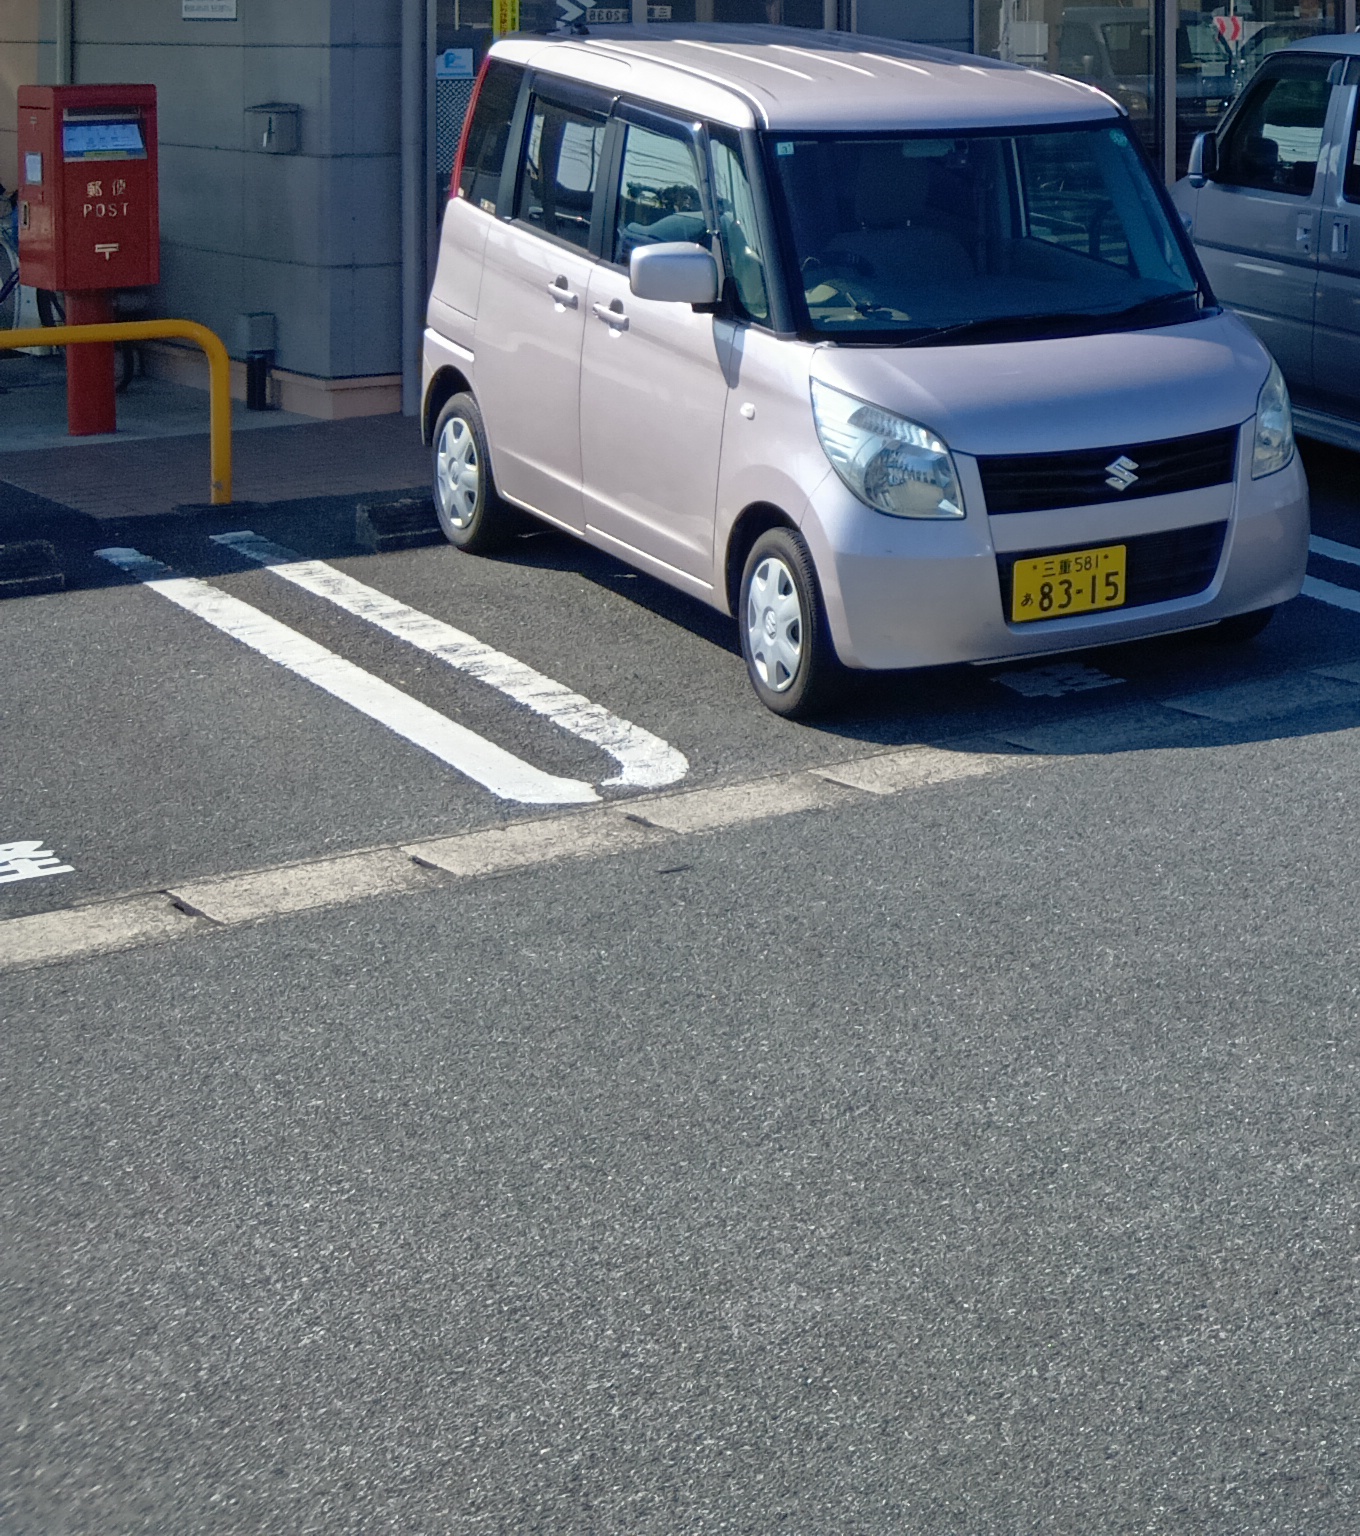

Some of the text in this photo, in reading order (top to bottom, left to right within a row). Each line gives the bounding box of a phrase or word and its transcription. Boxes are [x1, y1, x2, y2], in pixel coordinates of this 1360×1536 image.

[86, 179, 127, 197] 郵便
[83, 202, 130, 217] POST
[1042, 554, 1099, 578] 三重 581
[1020, 571, 1120, 612] あ 83-15
